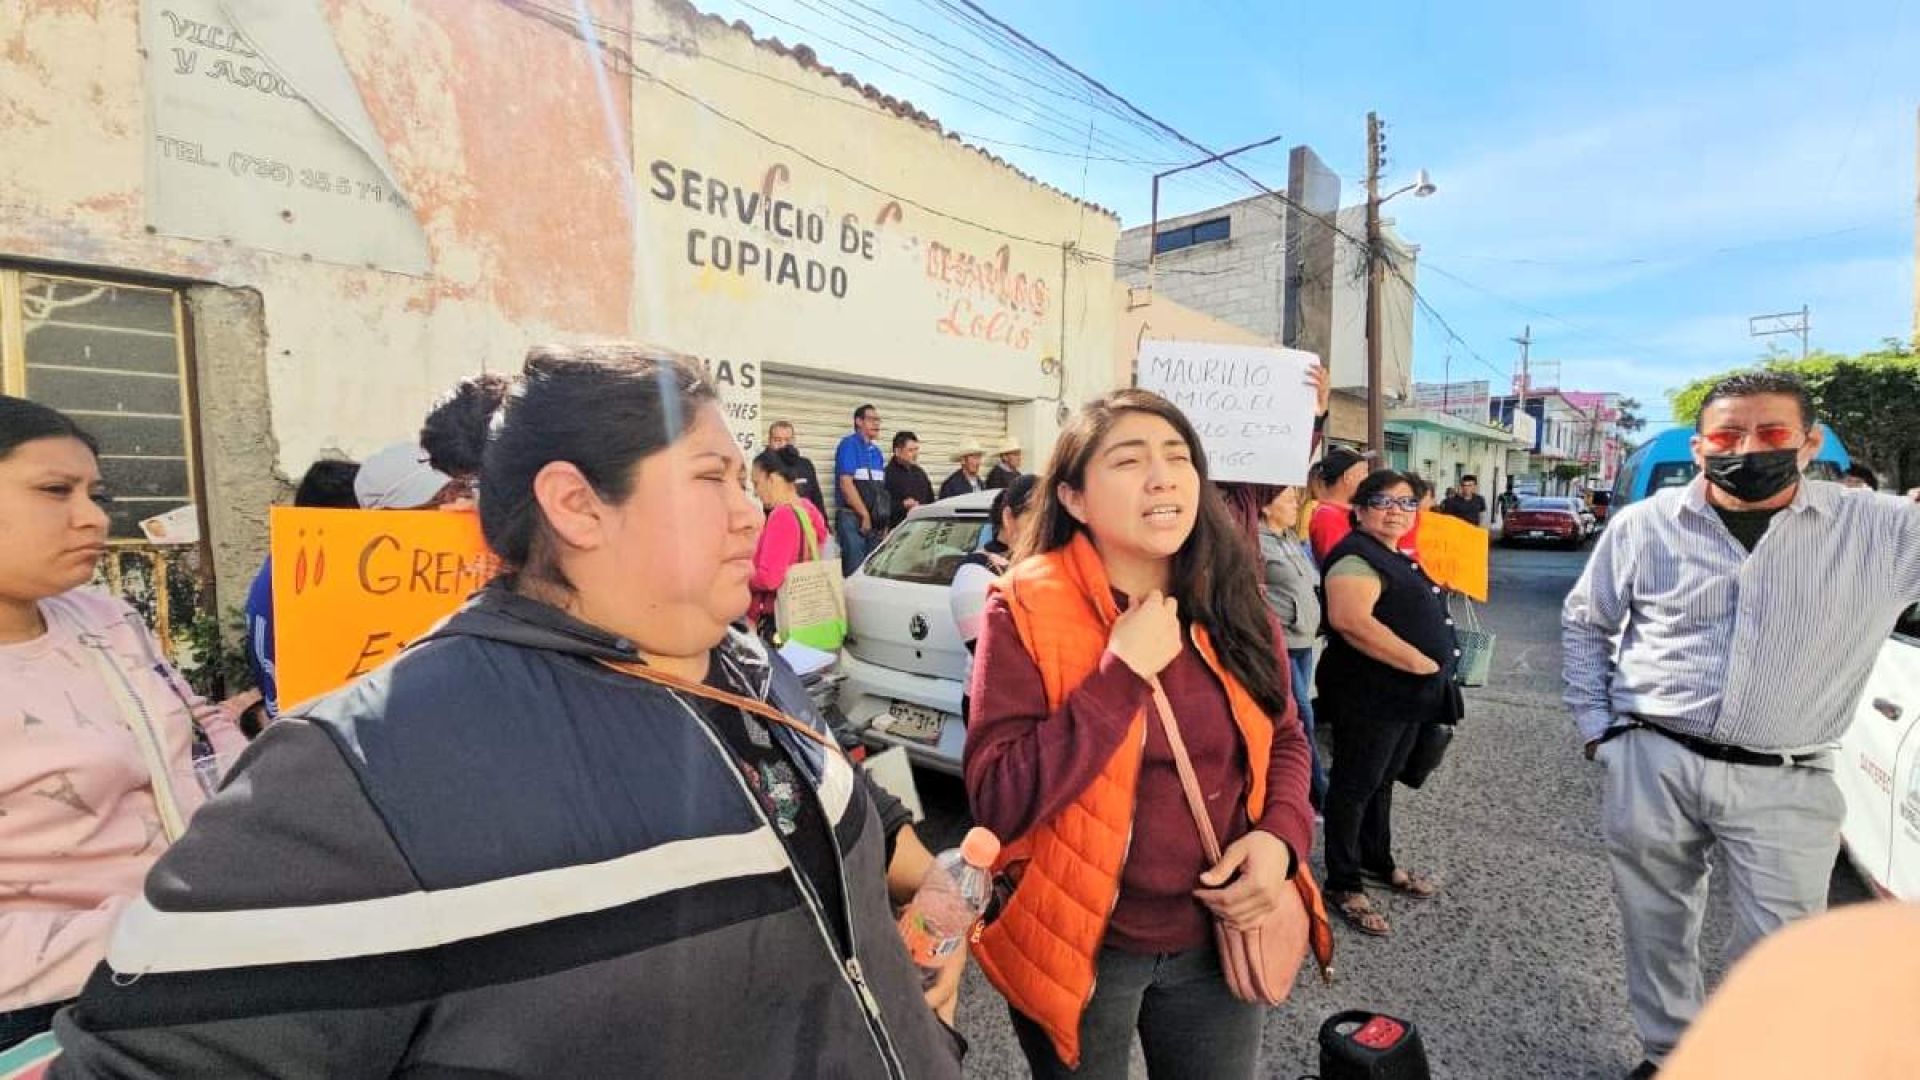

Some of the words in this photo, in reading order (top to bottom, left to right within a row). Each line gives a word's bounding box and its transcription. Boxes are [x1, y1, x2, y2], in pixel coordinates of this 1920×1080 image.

[161, 10, 257, 58] VILL
[171, 48, 198, 75] Y
[205, 60, 300, 99] ASOC
[156, 135, 219, 168] TEL.
[650, 159, 823, 244] SERVICIO
[839, 220, 875, 260] DE
[687, 228, 848, 299] COPIADO
[704, 358, 755, 389] AS
[1151, 356, 1271, 387] MAURILIO
[358, 533, 480, 595] GREM
